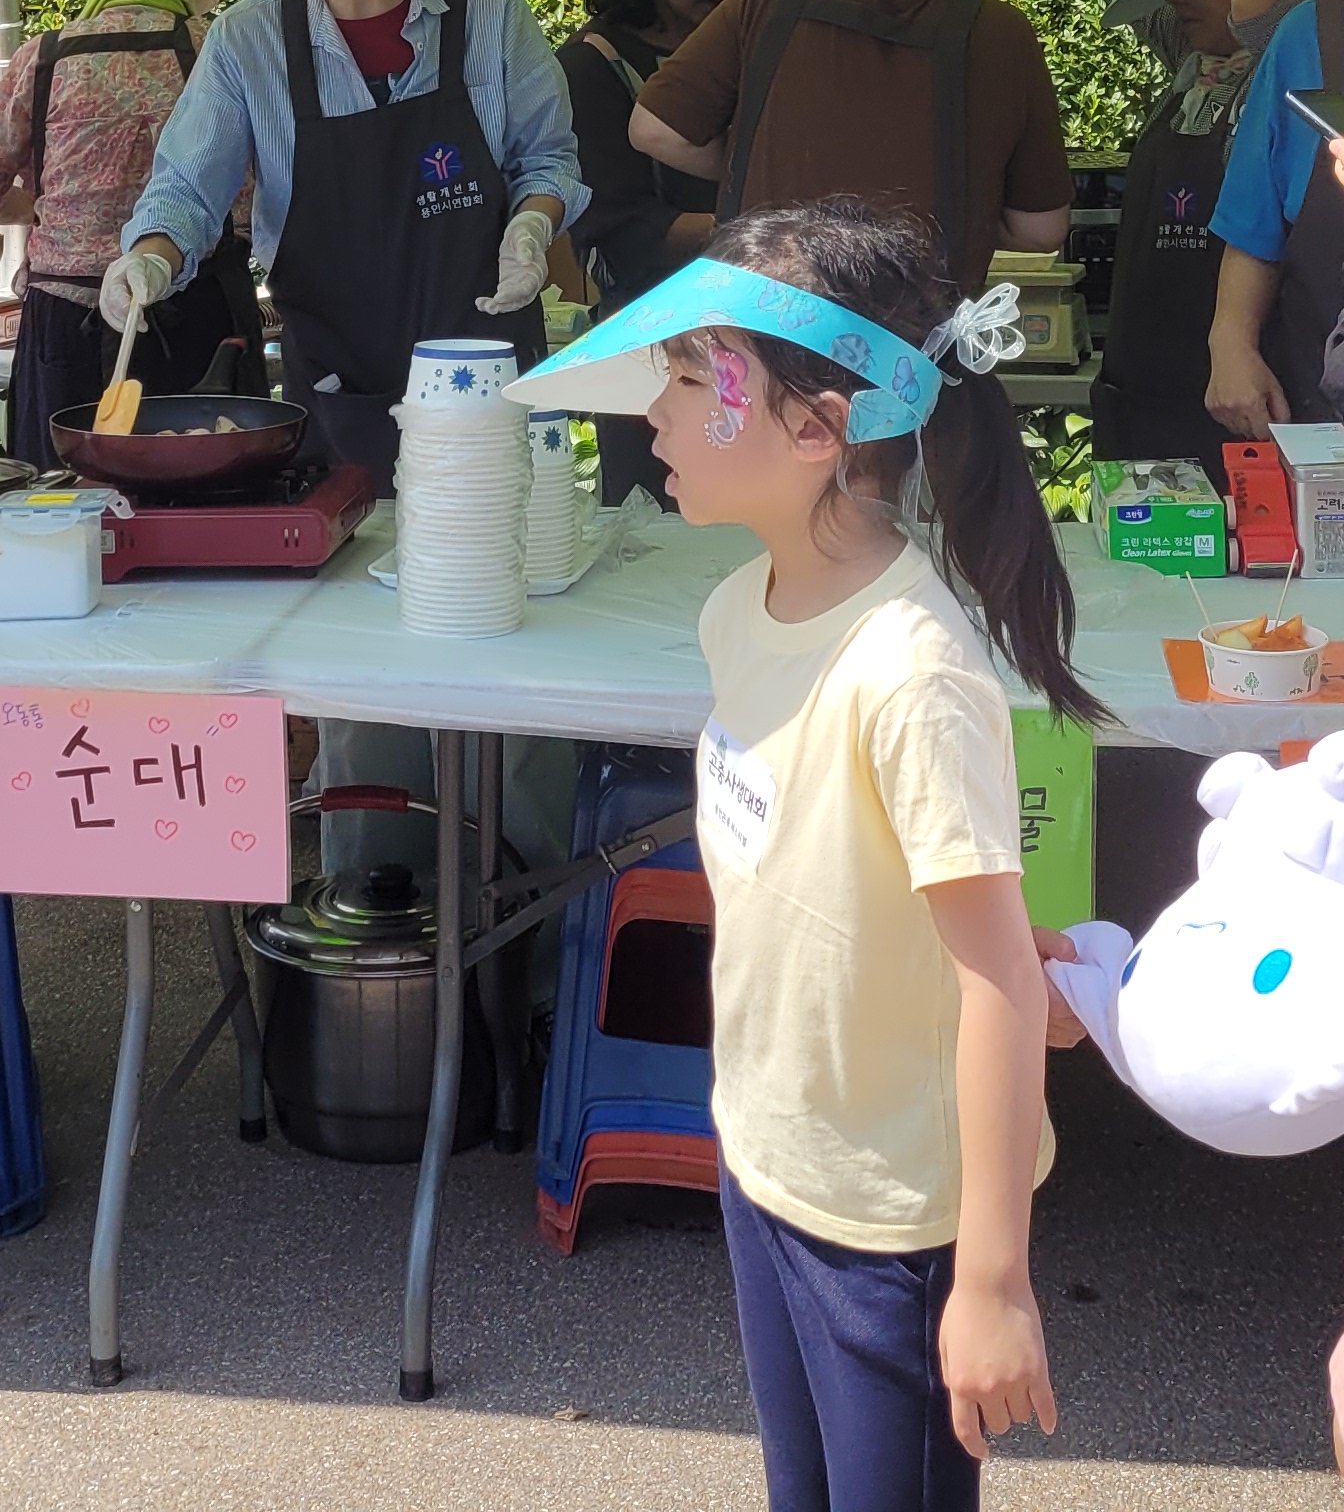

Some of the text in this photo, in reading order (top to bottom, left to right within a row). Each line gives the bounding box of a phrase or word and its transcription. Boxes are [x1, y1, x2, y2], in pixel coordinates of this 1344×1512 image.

[1121, 548, 1145, 557] Clean
[1147, 548, 1172, 557] Latex
[1199, 537, 1209, 547] M
[55, 725, 207, 829] 순대
[708, 750, 768, 823] 곤충사생대회
